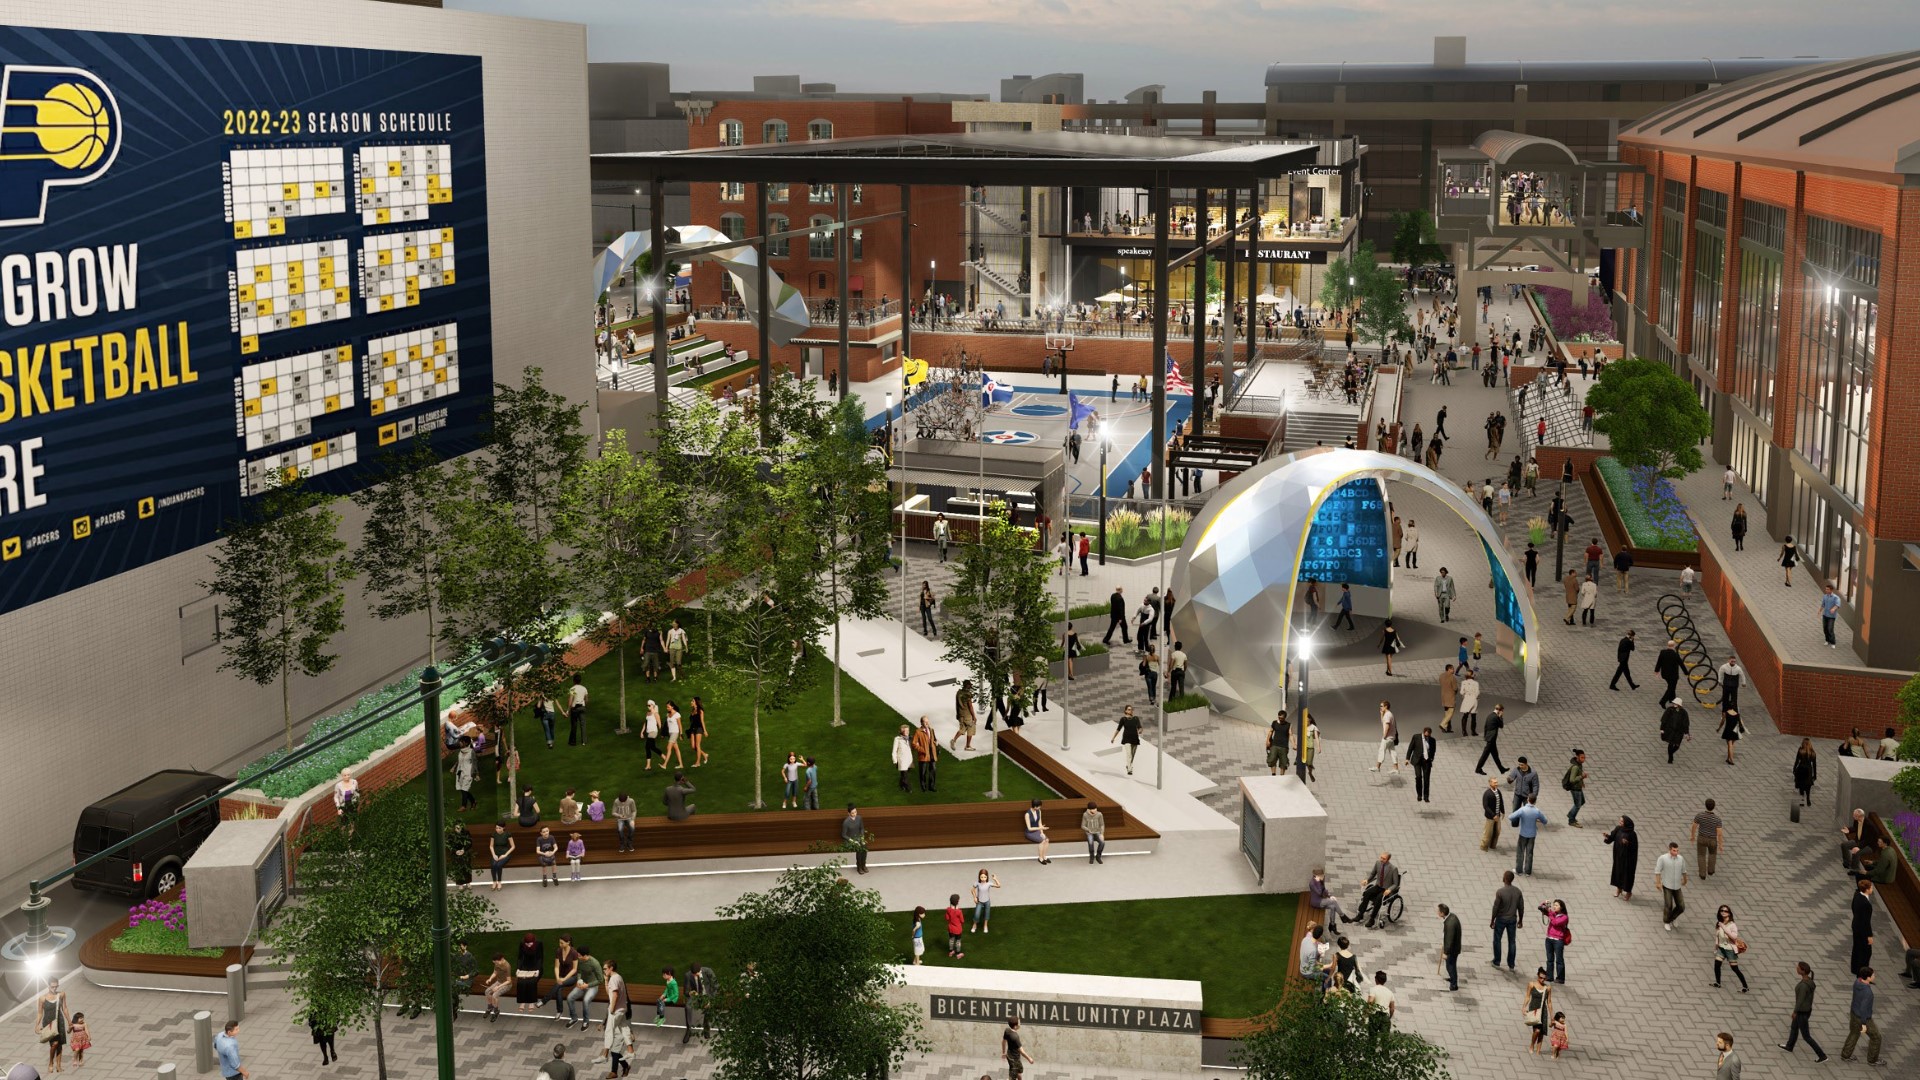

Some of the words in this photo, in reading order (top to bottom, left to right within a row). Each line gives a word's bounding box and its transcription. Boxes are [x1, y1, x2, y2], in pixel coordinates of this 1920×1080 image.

[223, 110, 301, 135] 2022-23
[308, 112, 371, 134] SEASON
[379, 112, 452, 133] SCHEDULE
[222, 162, 231, 183] 2017
[1312, 166, 1340, 175] Center
[223, 184, 233, 223] OCTOBER
[1117, 248, 1153, 257] speakeasy
[3, 243, 138, 328] GROW
[228, 270, 237, 290] 2017
[229, 290, 239, 333] DECEMBER
[235, 400, 245, 438] FEBRUARY
[937, 998, 1070, 1022] BICENTENNIAL
[1077, 1006, 1130, 1026] UNITY
[1137, 1009, 1194, 1029] PLAZA
